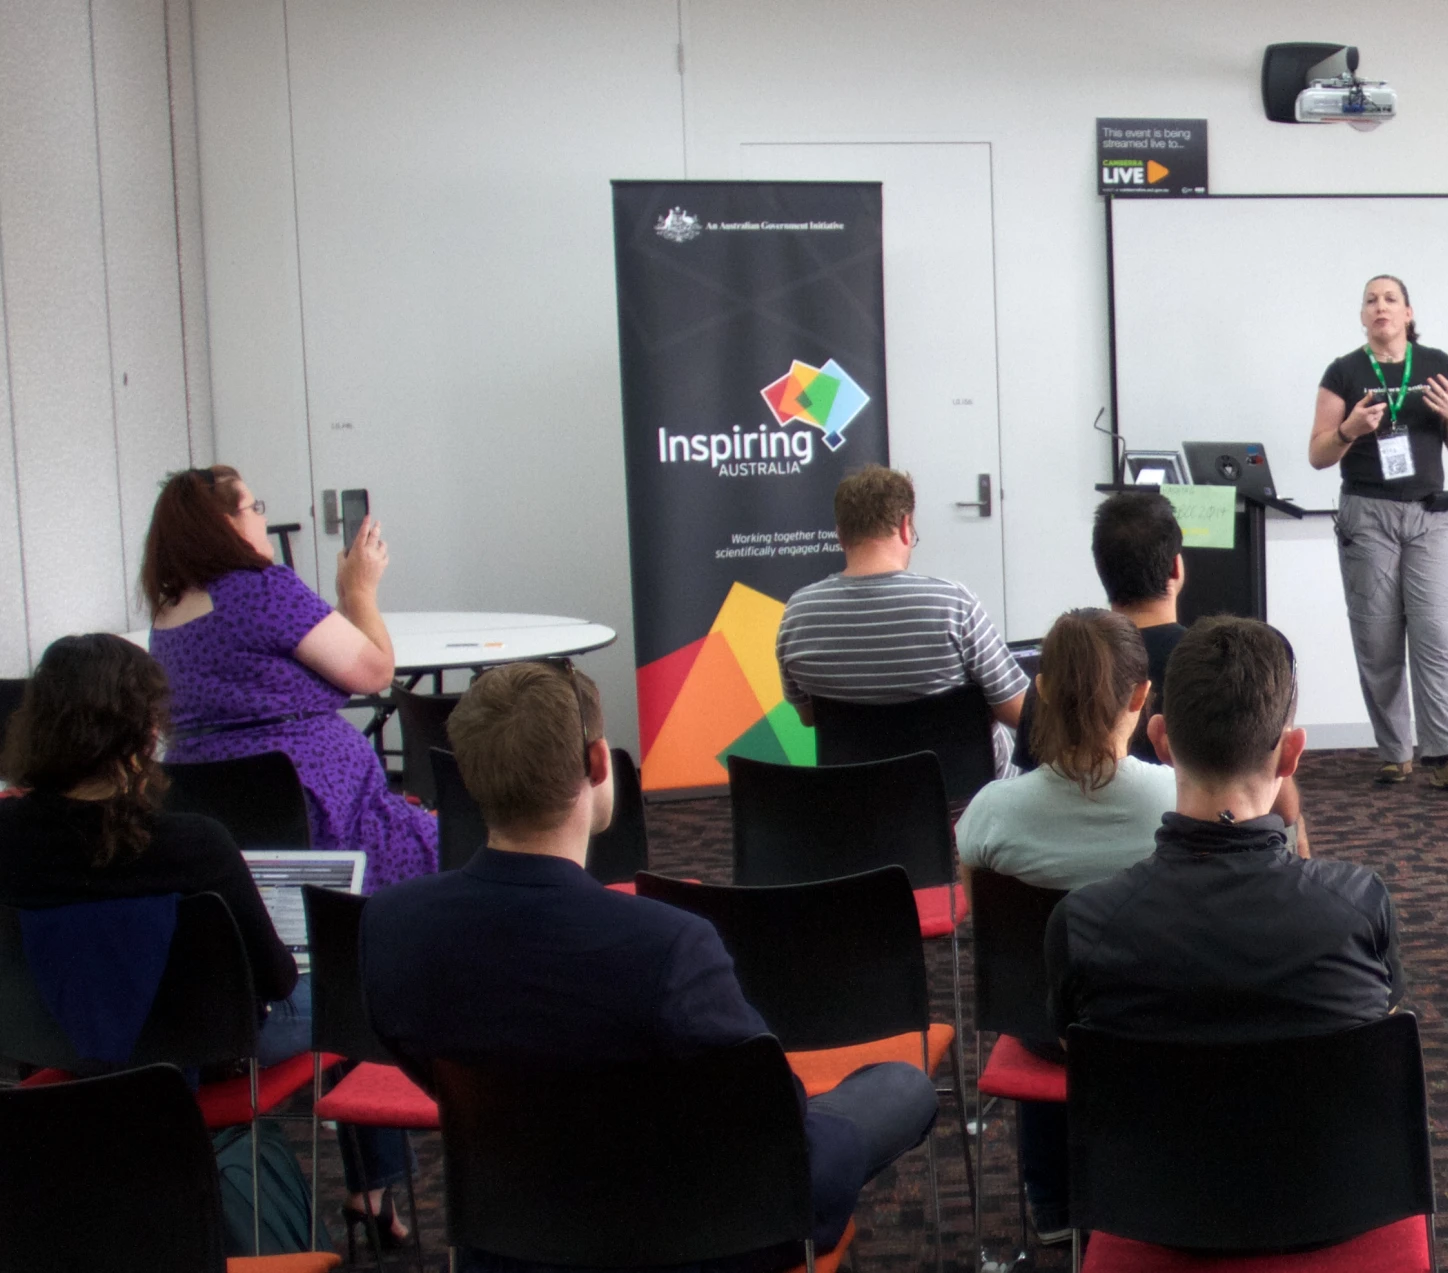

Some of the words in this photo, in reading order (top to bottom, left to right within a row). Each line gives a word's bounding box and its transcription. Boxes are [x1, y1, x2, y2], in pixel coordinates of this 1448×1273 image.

[1102, 127, 1122, 138] This
[1125, 128, 1151, 138] event
[1153, 128, 1161, 138] is
[1164, 128, 1191, 141] being
[1102, 139, 1148, 149] streamed
[1150, 139, 1166, 149] live
[1102, 167, 1144, 184] LIVE
[705, 221, 718, 230] An
[719, 221, 760, 230] Australian
[761, 221, 808, 230] Government
[809, 221, 845, 230] Initiative
[658, 425, 813, 468] Inspiring
[718, 461, 801, 477] AUSTRALIA
[731, 532, 772, 545] Working
[773, 530, 815, 544] together
[715, 545, 776, 559] scientifically
[777, 543, 819, 556] engaged
